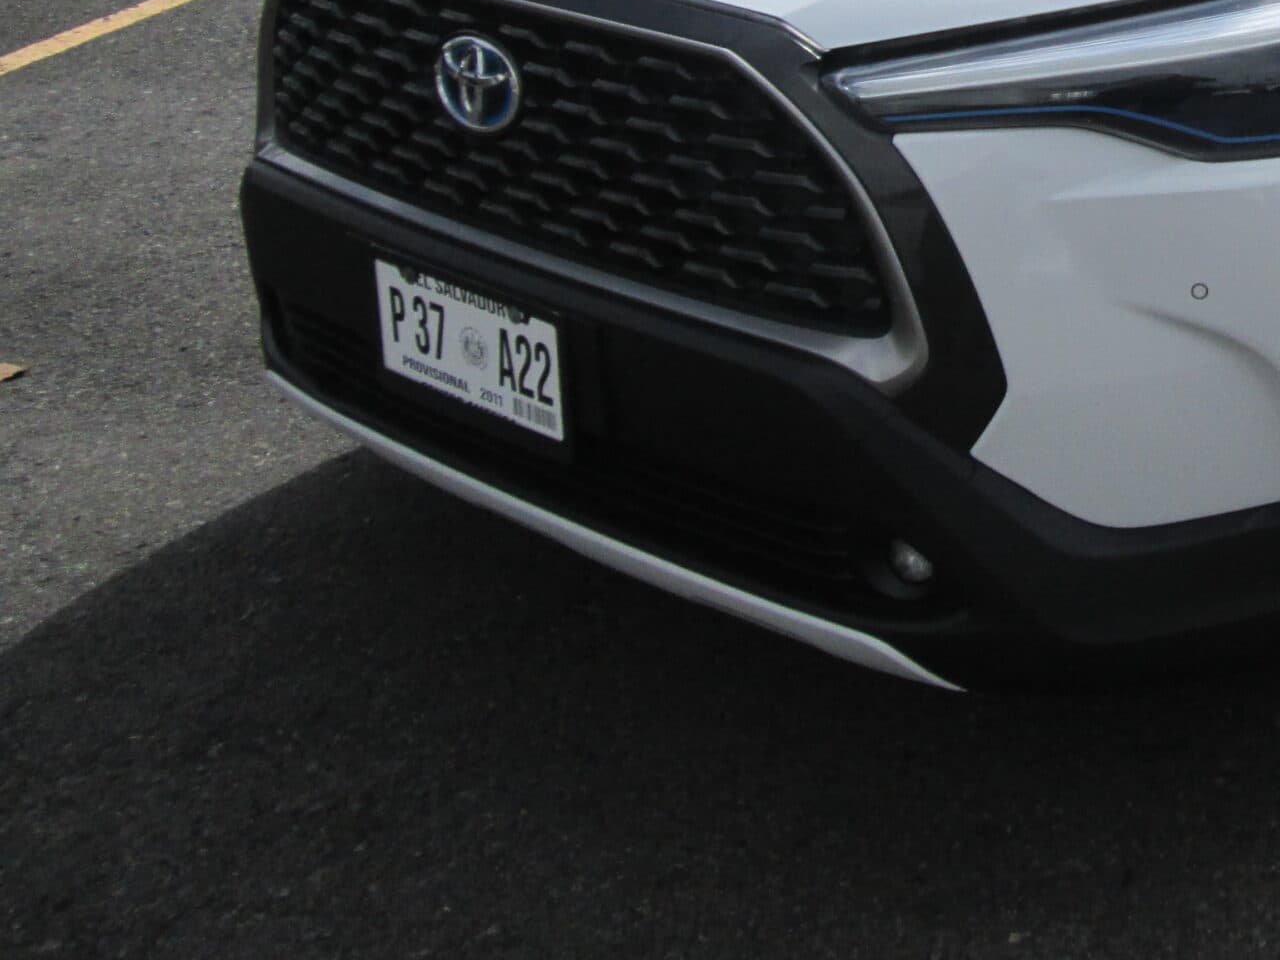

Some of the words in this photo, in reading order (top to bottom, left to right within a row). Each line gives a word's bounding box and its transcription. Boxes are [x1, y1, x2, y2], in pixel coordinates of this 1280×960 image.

[416, 272, 432, 290] EL
[434, 279, 506, 319] SALVADOR
[389, 286, 406, 342] P
[412, 295, 445, 360] 37
[499, 327, 554, 407] A22
[402, 355, 471, 394] PROVISIONAL
[479, 387, 503, 409] 2011
